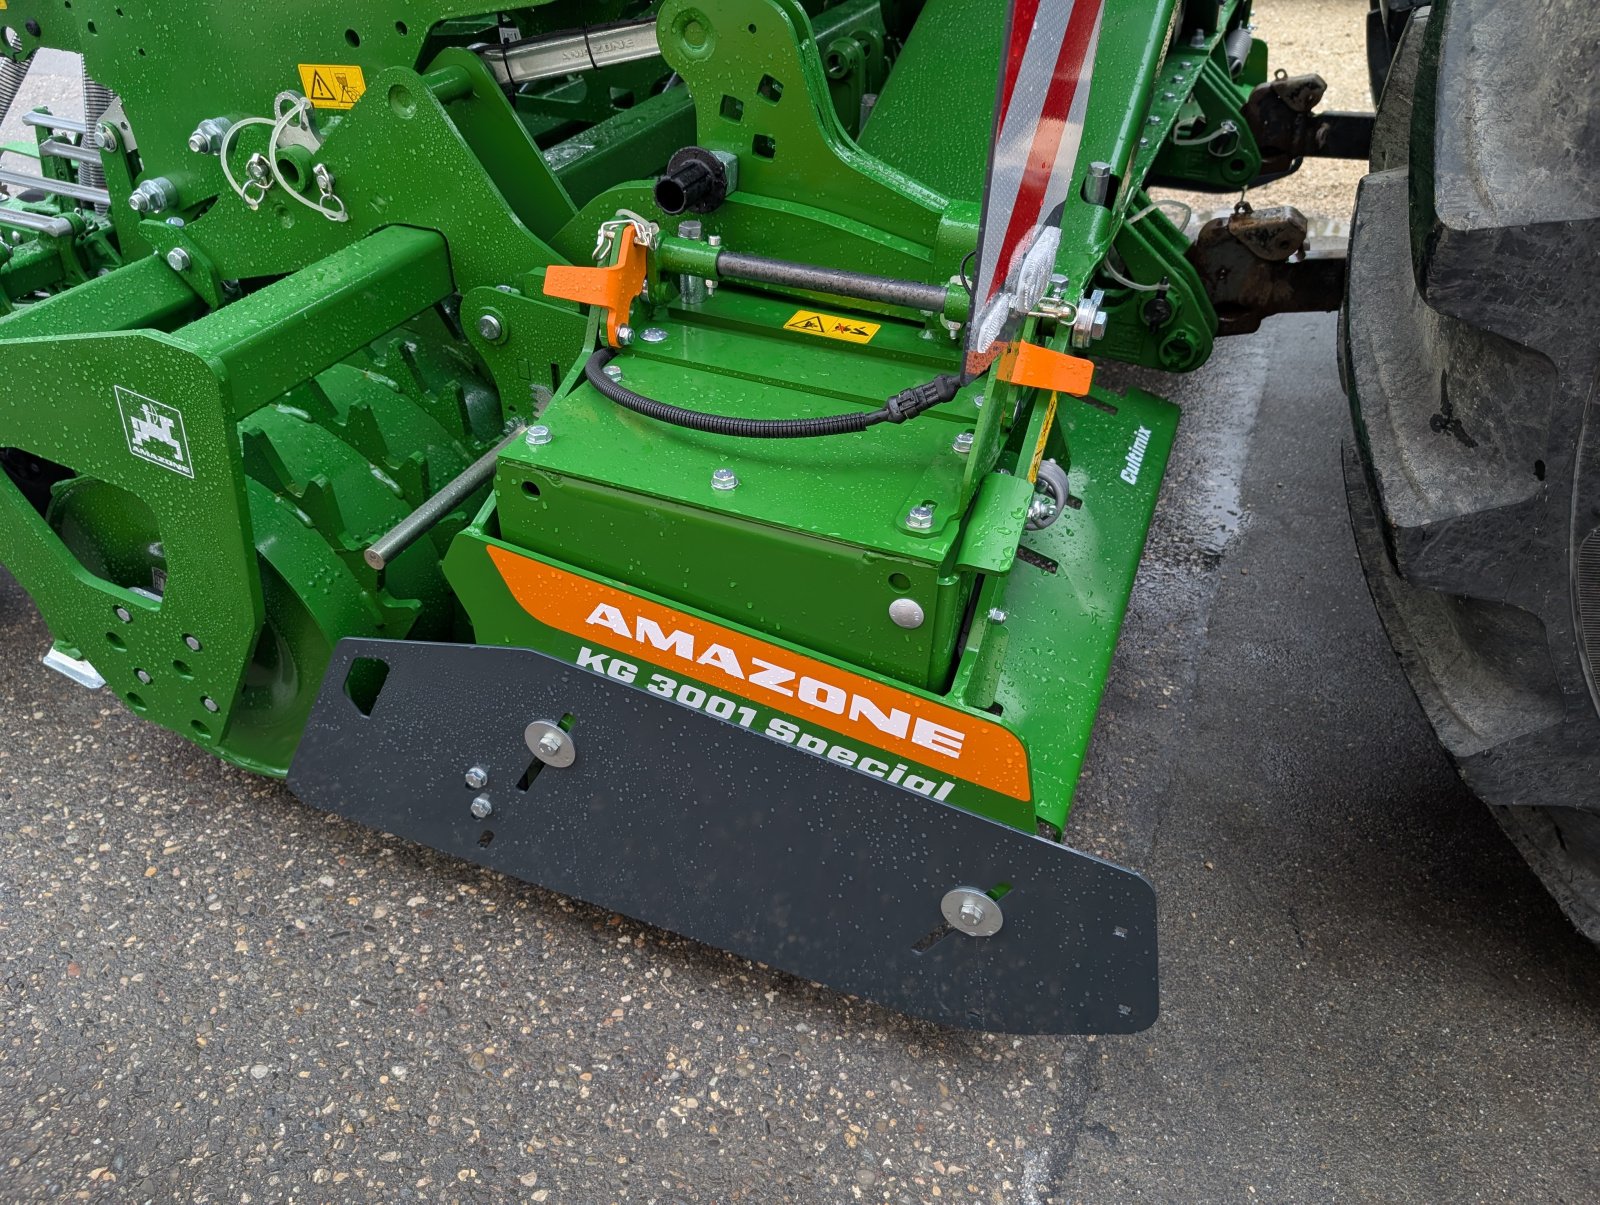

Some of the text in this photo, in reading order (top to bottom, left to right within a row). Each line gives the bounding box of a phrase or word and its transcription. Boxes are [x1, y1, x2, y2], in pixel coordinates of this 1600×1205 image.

[132, 445, 190, 473] AMAZONE
[1120, 425, 1152, 485] Cultimix
[576, 646, 956, 801] KG 3001 Special
[585, 602, 966, 759] AMAZONE
